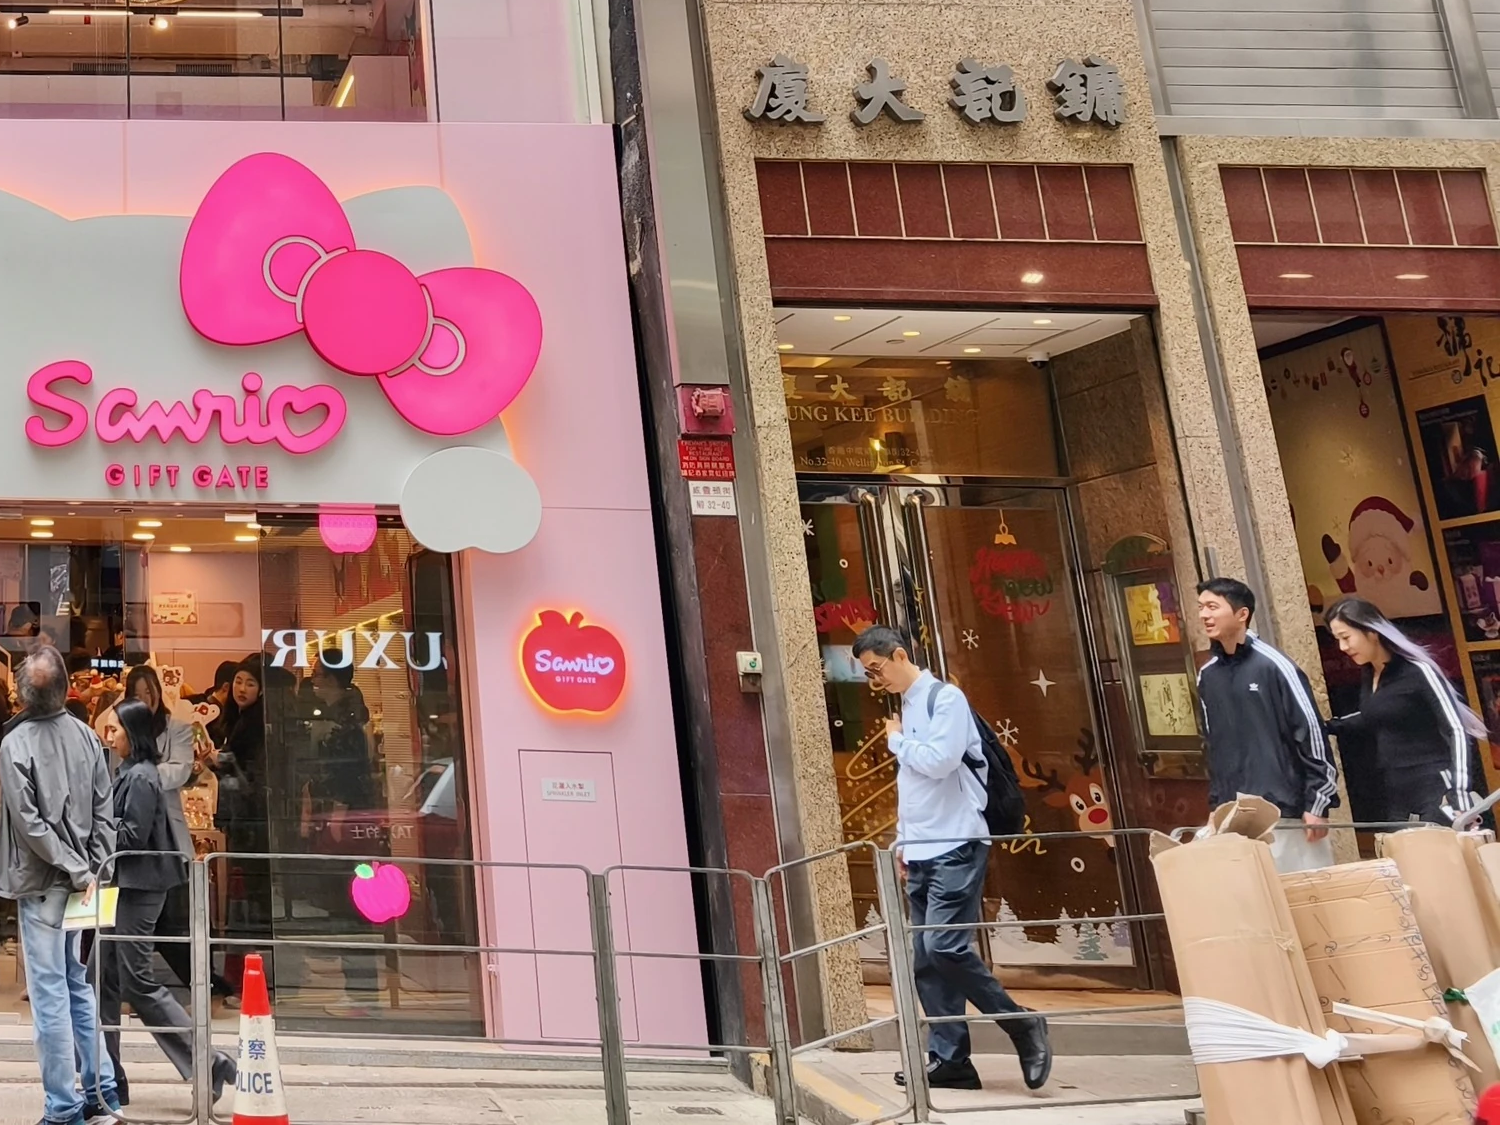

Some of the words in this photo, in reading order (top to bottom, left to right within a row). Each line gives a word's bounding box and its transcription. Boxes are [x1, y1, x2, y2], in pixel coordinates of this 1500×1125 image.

[25, 360, 347, 454] Sanrio
[835, 407, 875, 422] KEE
[105, 464, 180, 488] GIFT
[193, 465, 269, 489] GATE
[707, 500, 731, 510] 32-40
[534, 650, 614, 675] Sanrio
[577, 676, 596, 684] GATE
